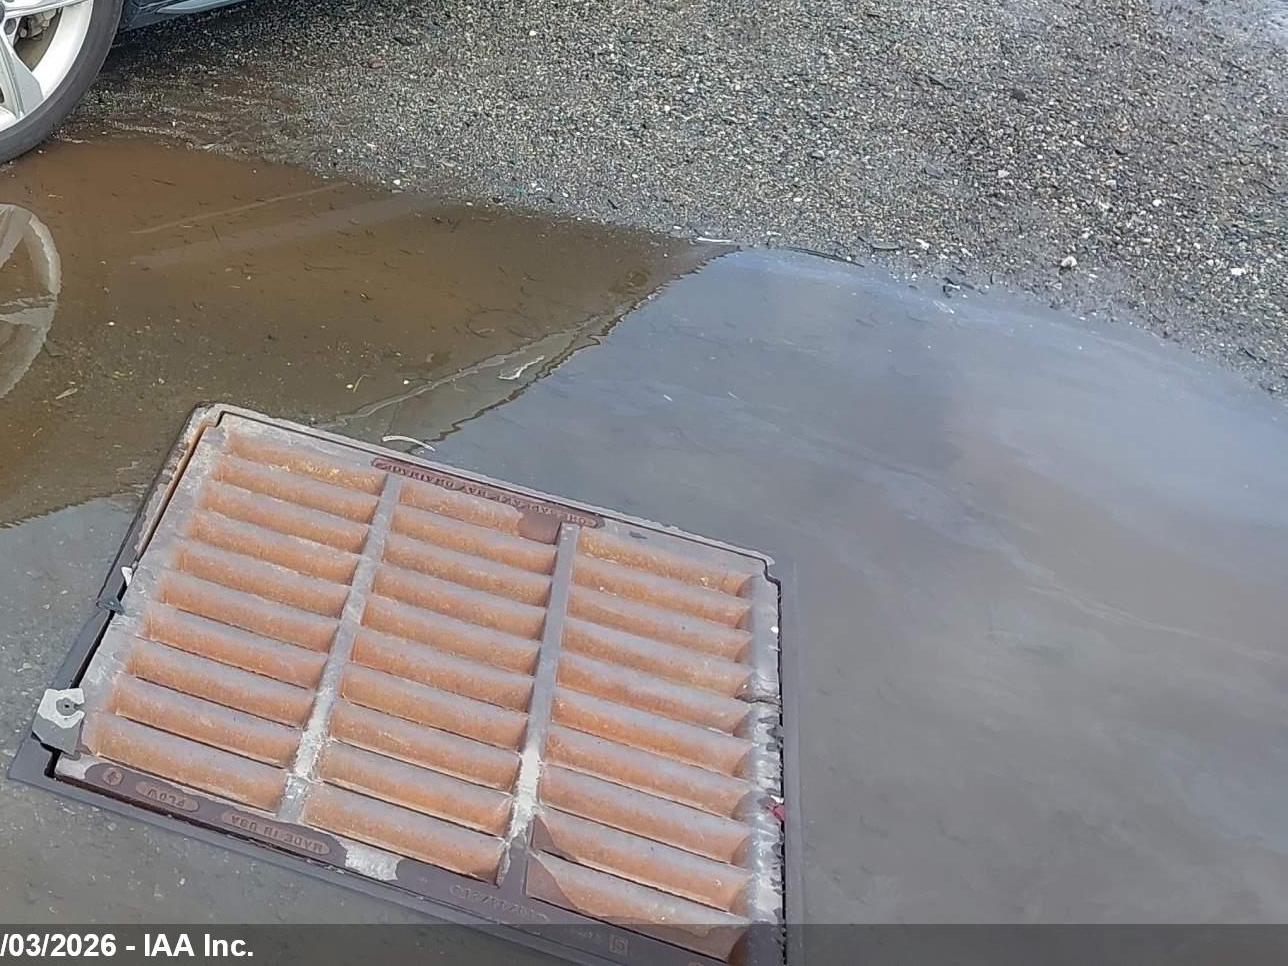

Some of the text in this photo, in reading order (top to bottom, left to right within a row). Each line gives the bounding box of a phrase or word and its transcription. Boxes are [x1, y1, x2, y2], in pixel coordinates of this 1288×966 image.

[147, 787, 186, 808] FLOW
[231, 814, 324, 853] MADE IN USA
